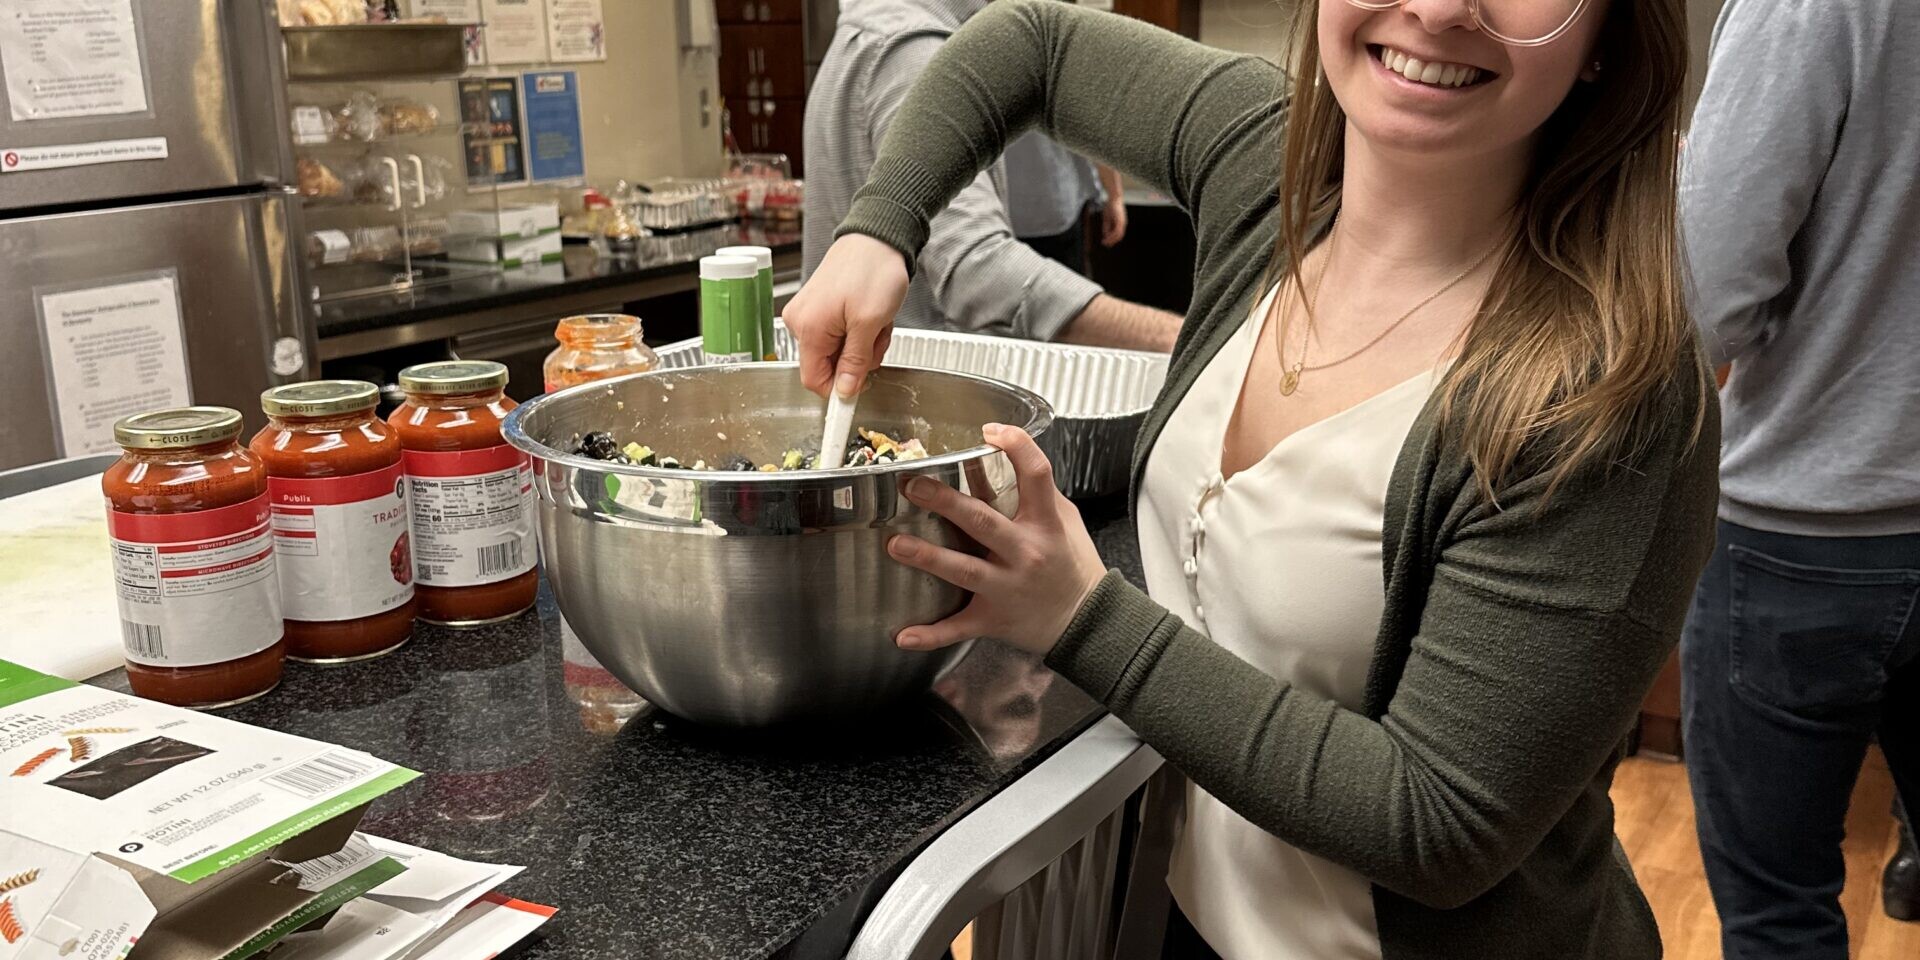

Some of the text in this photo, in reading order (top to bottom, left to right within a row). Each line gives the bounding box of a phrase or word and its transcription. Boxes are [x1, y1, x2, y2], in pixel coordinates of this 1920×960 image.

[76, 149, 99, 158] personal
[290, 405, 314, 413] CLOSE
[162, 434, 190, 444] CLOSE
[412, 480, 438, 488] Nutrition
[284, 494, 310, 502] Publix
[198, 542, 226, 550] STOVETOP
[198, 565, 232, 574] MICROWAVE
[148, 802, 173, 814] NET
[172, 793, 193, 804] WT
[192, 785, 210, 794] 12
[209, 776, 226, 787] OZ
[146, 818, 192, 840] ROTINI
[162, 859, 184, 869] BEST
[81, 929, 102, 953] CT001
